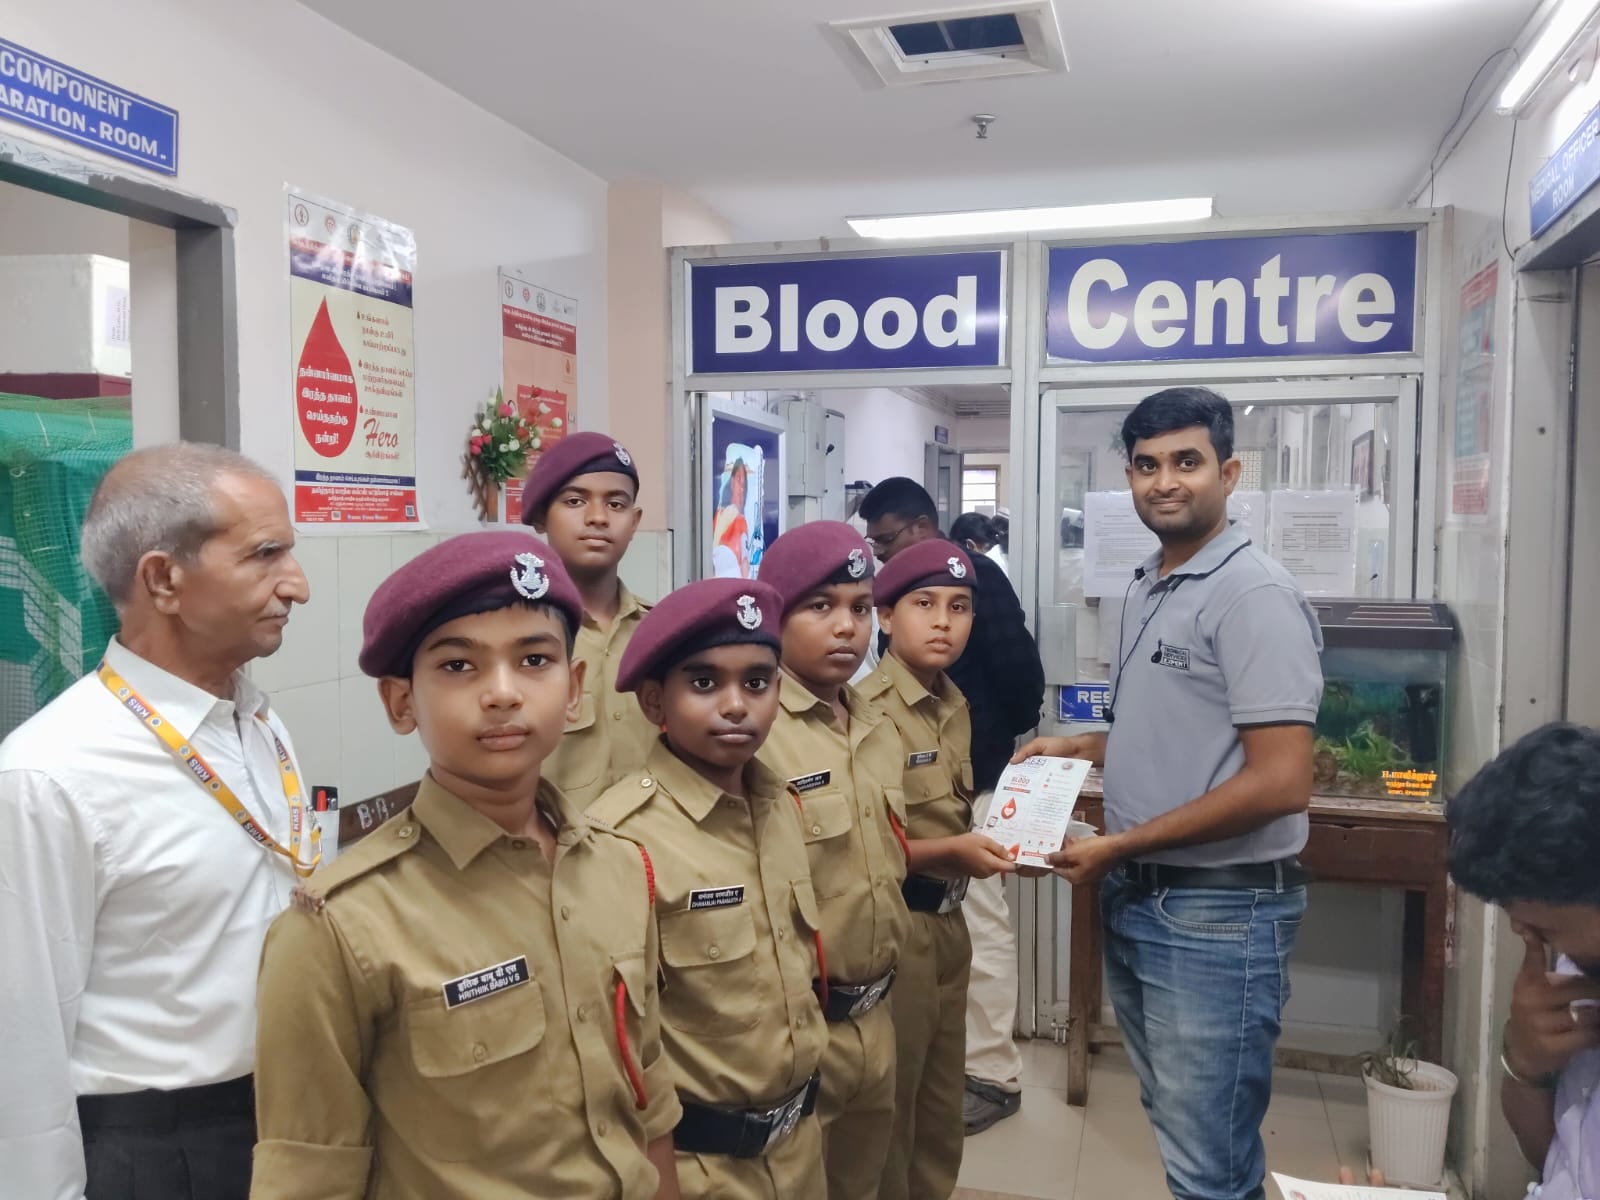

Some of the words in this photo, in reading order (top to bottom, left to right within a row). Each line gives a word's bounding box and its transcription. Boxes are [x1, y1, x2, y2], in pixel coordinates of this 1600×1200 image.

[0, 51, 132, 121] COMPONENT
[1552, 170, 1575, 211] ROOM
[715, 275, 977, 354] Blood
[1067, 253, 1396, 350] Centre
[302, 387, 326, 402] இரத்த
[326, 392, 353, 404] தானம்
[306, 409, 349, 426] செய்ததற்கு
[315, 431, 339, 445] நன்றி!
[363, 418, 399, 448] Hero
[128, 698, 150, 718] KMS
[189, 758, 211, 782] KMS
[292, 807, 300, 831] KMS
[244, 822, 265, 842] KMS
[489, 977, 508, 990] BABU
